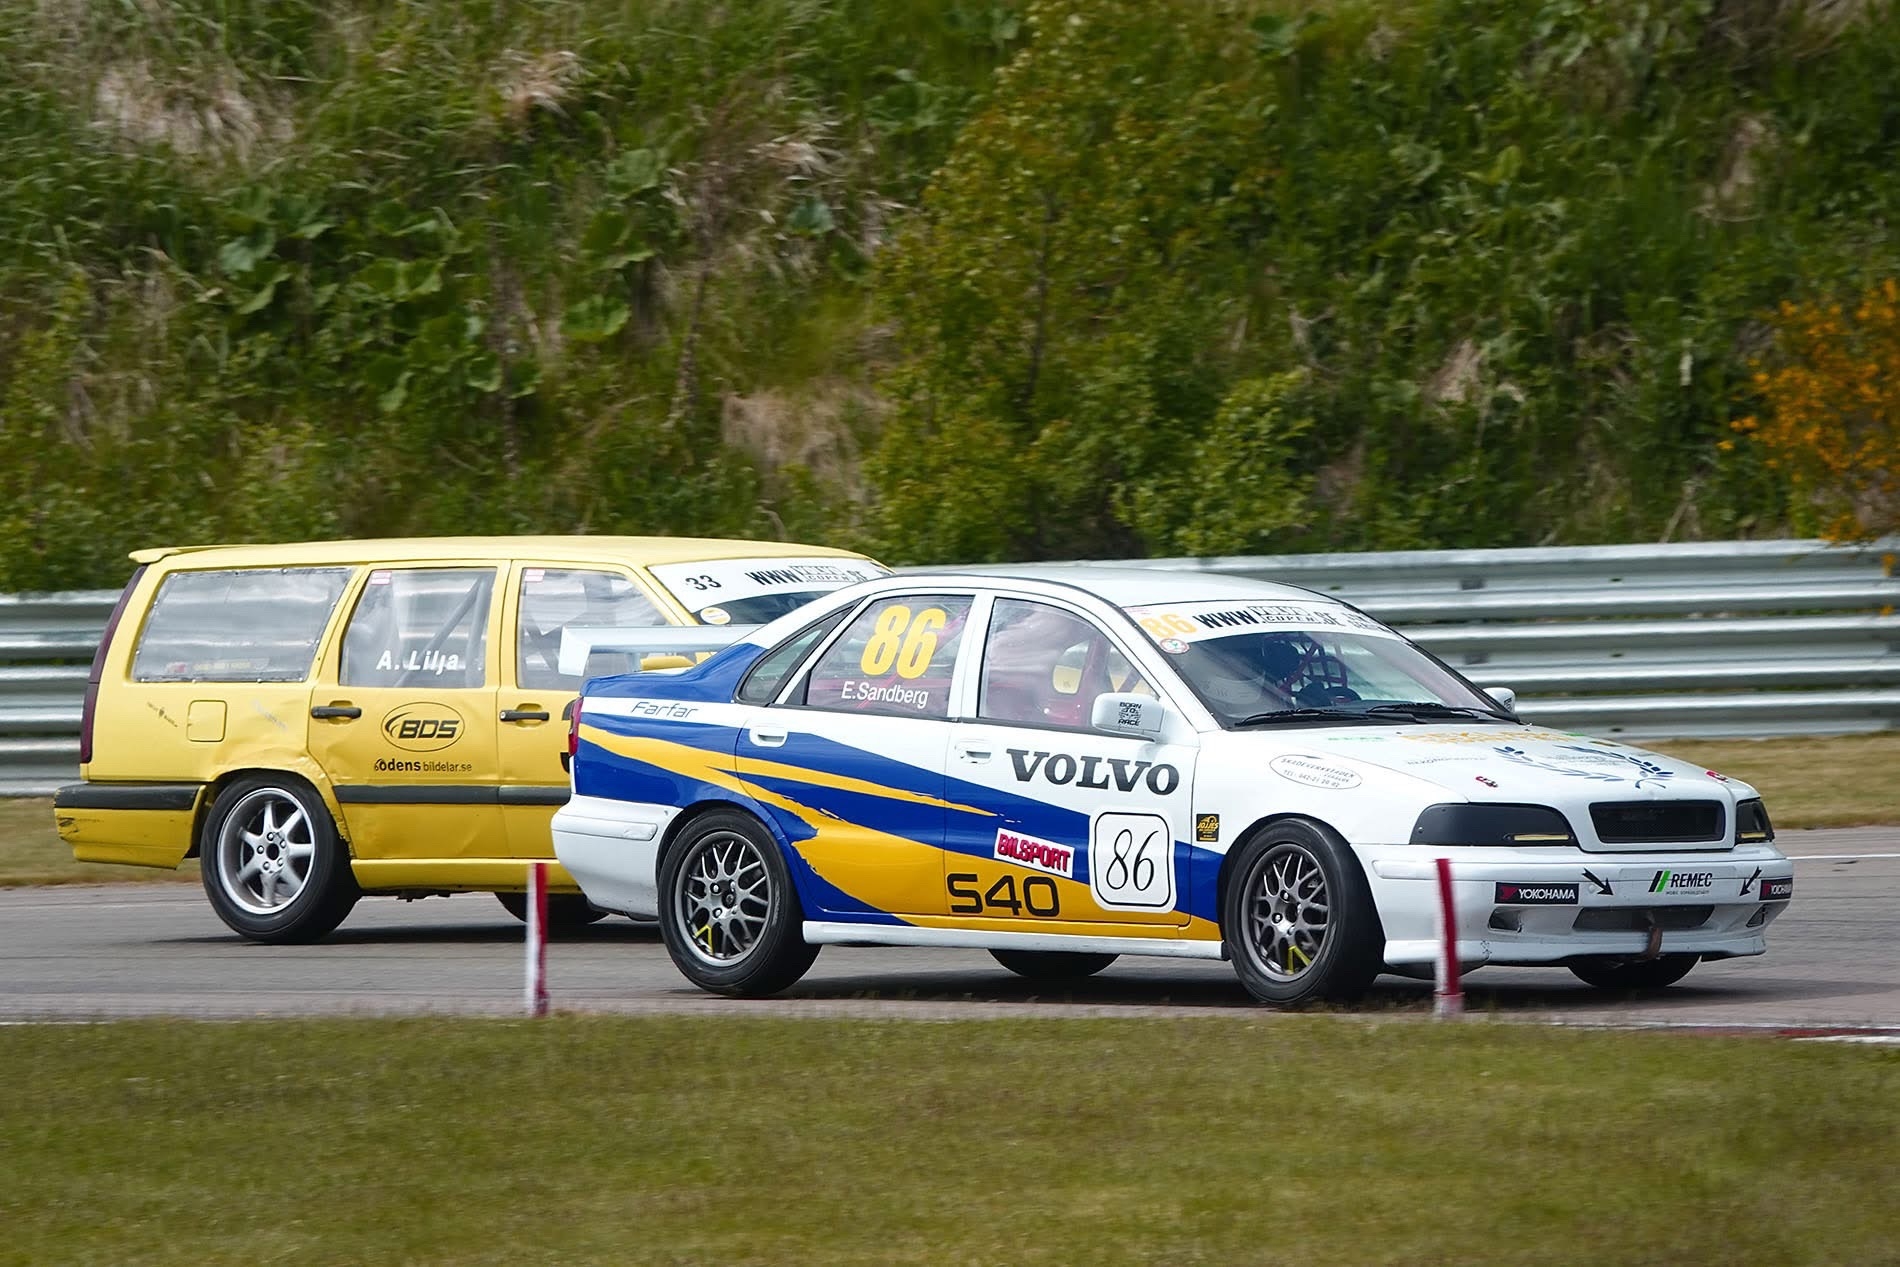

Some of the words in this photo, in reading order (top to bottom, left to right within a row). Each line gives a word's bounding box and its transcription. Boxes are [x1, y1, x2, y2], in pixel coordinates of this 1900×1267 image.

[685, 574, 722, 590] 33
[1140, 613, 1197, 638] 86
[860, 605, 947, 679] 86
[376, 650, 400, 670] A.
[407, 650, 459, 675] Lilja
[841, 680, 929, 709] E.Sandberg
[630, 701, 699, 718] Farfar
[398, 719, 460, 739] BDS
[423, 761, 473, 772] bildelar.se
[1006, 748, 1180, 796] VOLVO
[997, 833, 1071, 873] BILSPORT
[1106, 828, 1159, 891] 86
[1670, 872, 1713, 889] REMEC
[947, 873, 1060, 918] S40
[1518, 887, 1576, 900] YOKOHAMA
